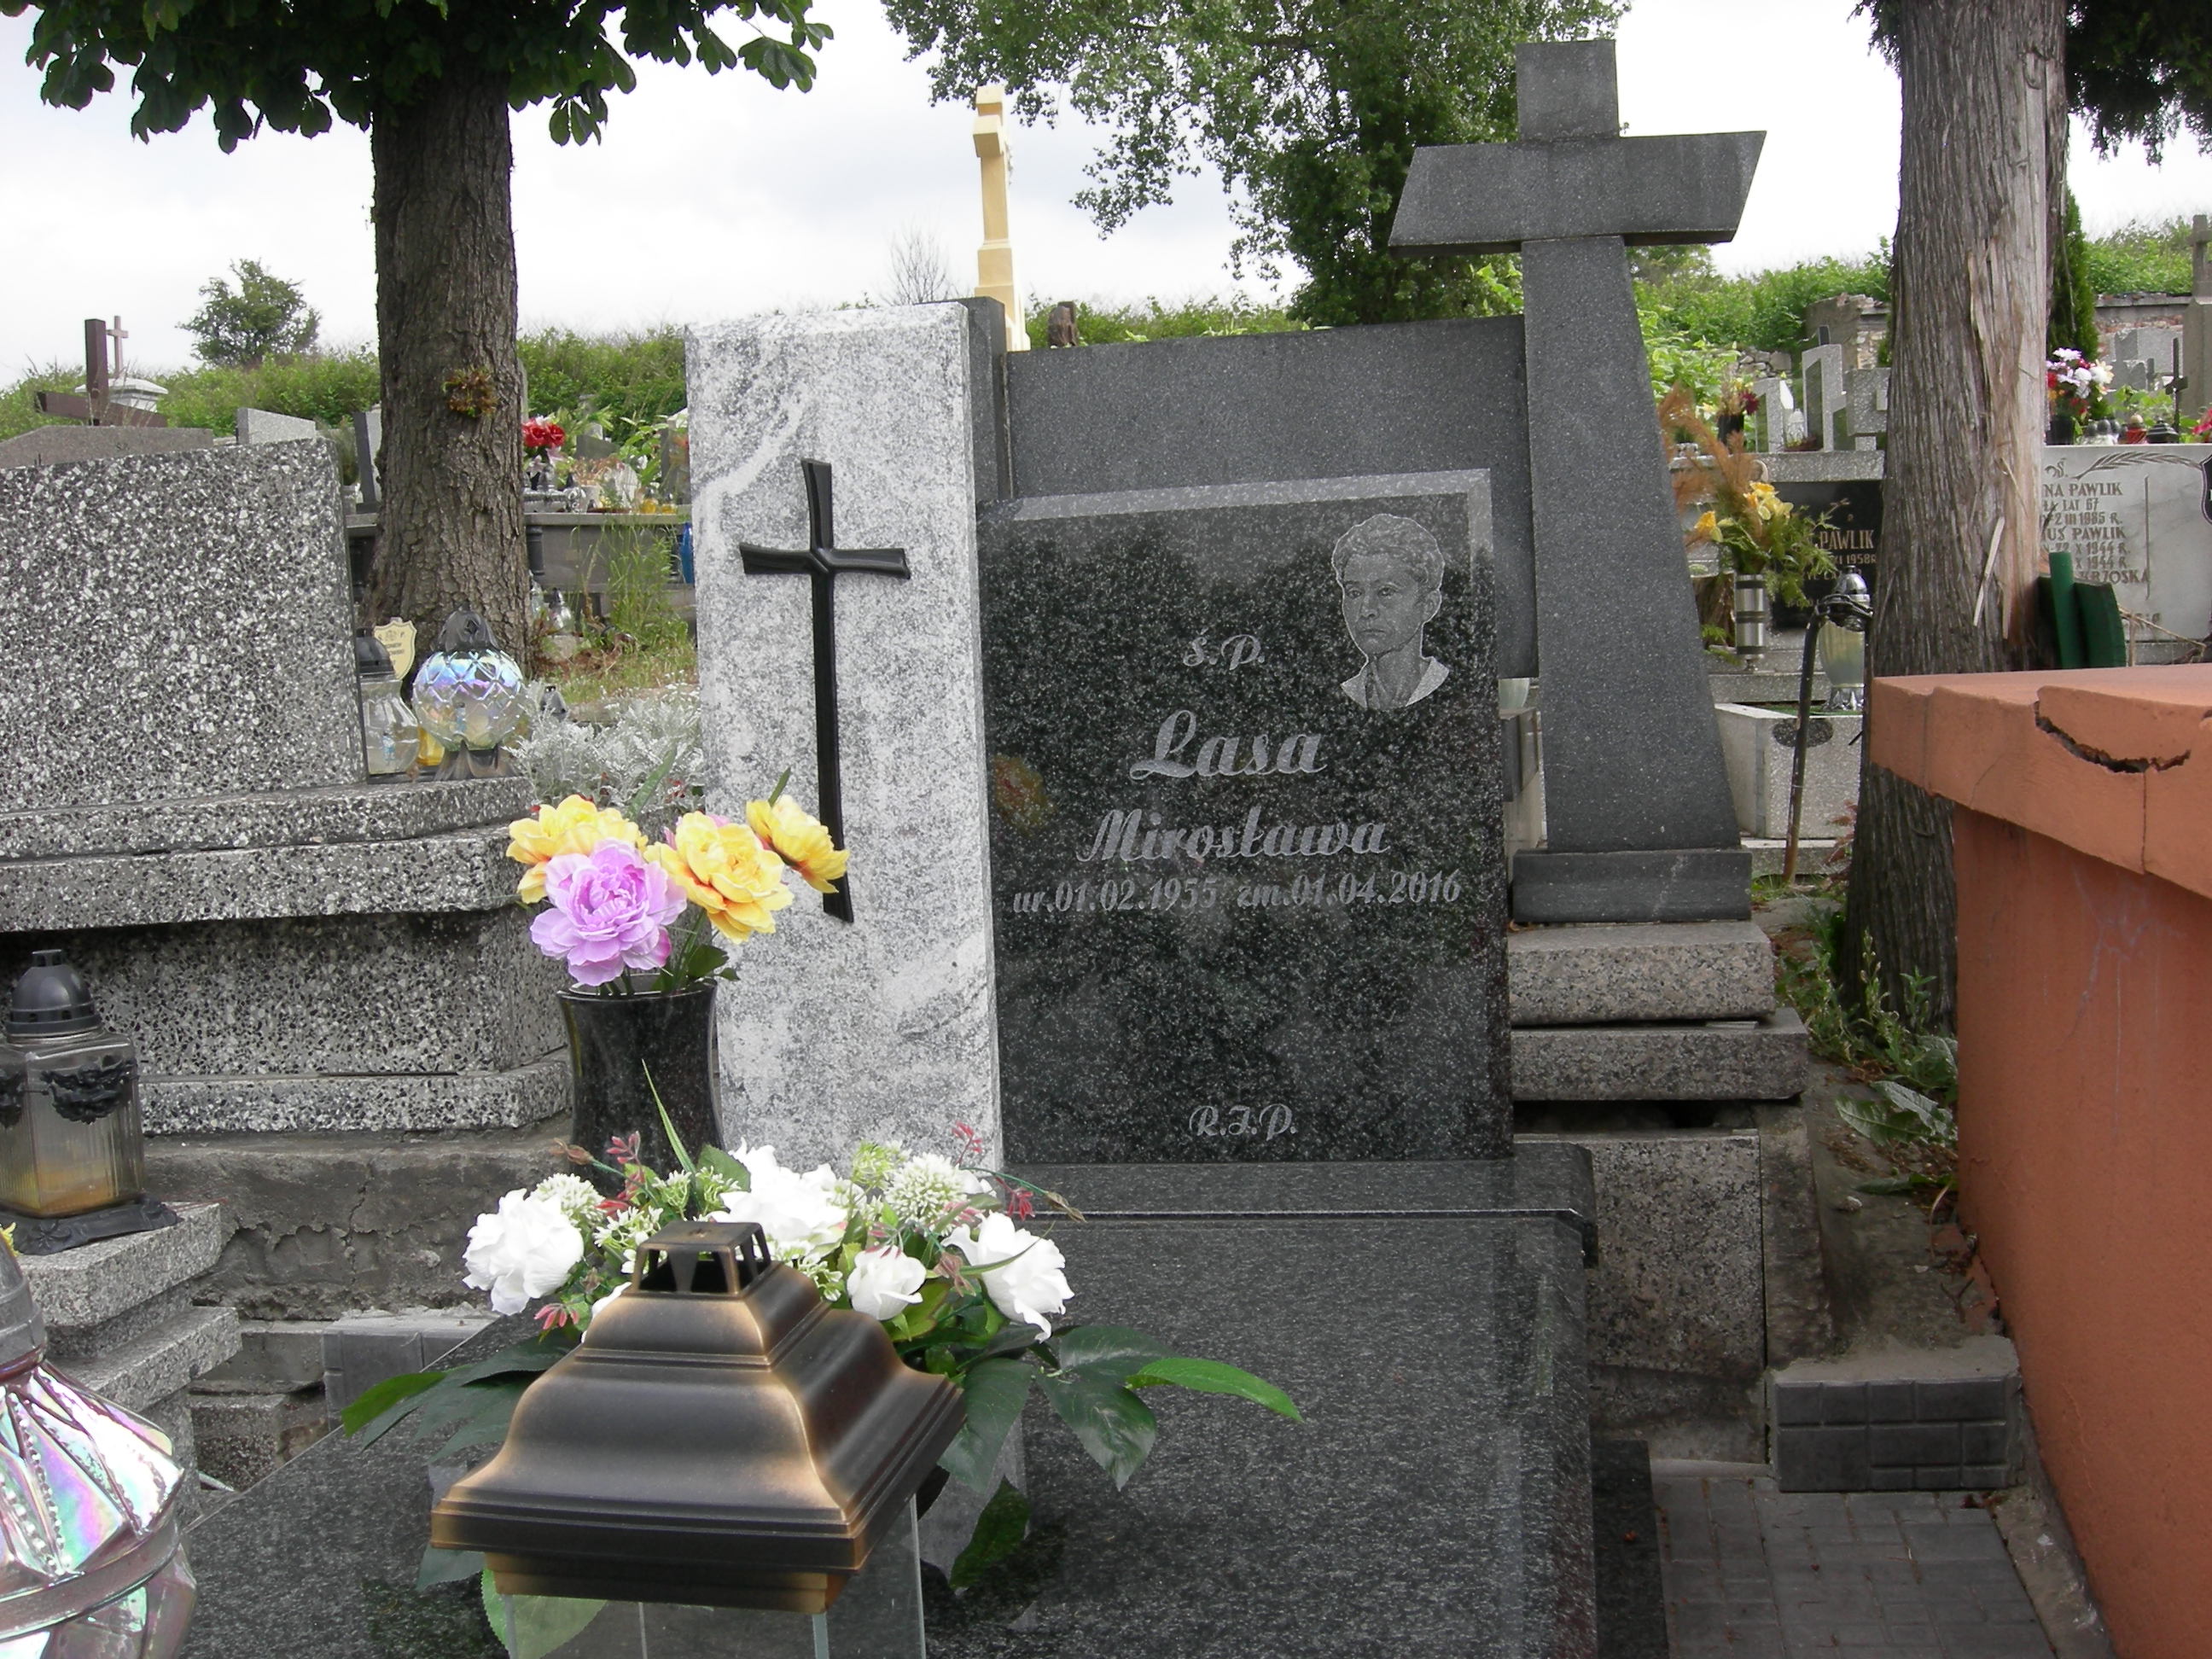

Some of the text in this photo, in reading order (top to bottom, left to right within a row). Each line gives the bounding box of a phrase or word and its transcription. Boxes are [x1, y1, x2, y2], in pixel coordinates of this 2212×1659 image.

[2069, 482, 2123, 497] PAWLIK
[2063, 498, 2081, 511] LAT
[1819, 530, 1875, 550] PAWLIK
[2072, 527, 2127, 541] PAWLIK
[1129, 709, 1328, 780] Lasa
[1075, 806, 1390, 863] Mirosława
